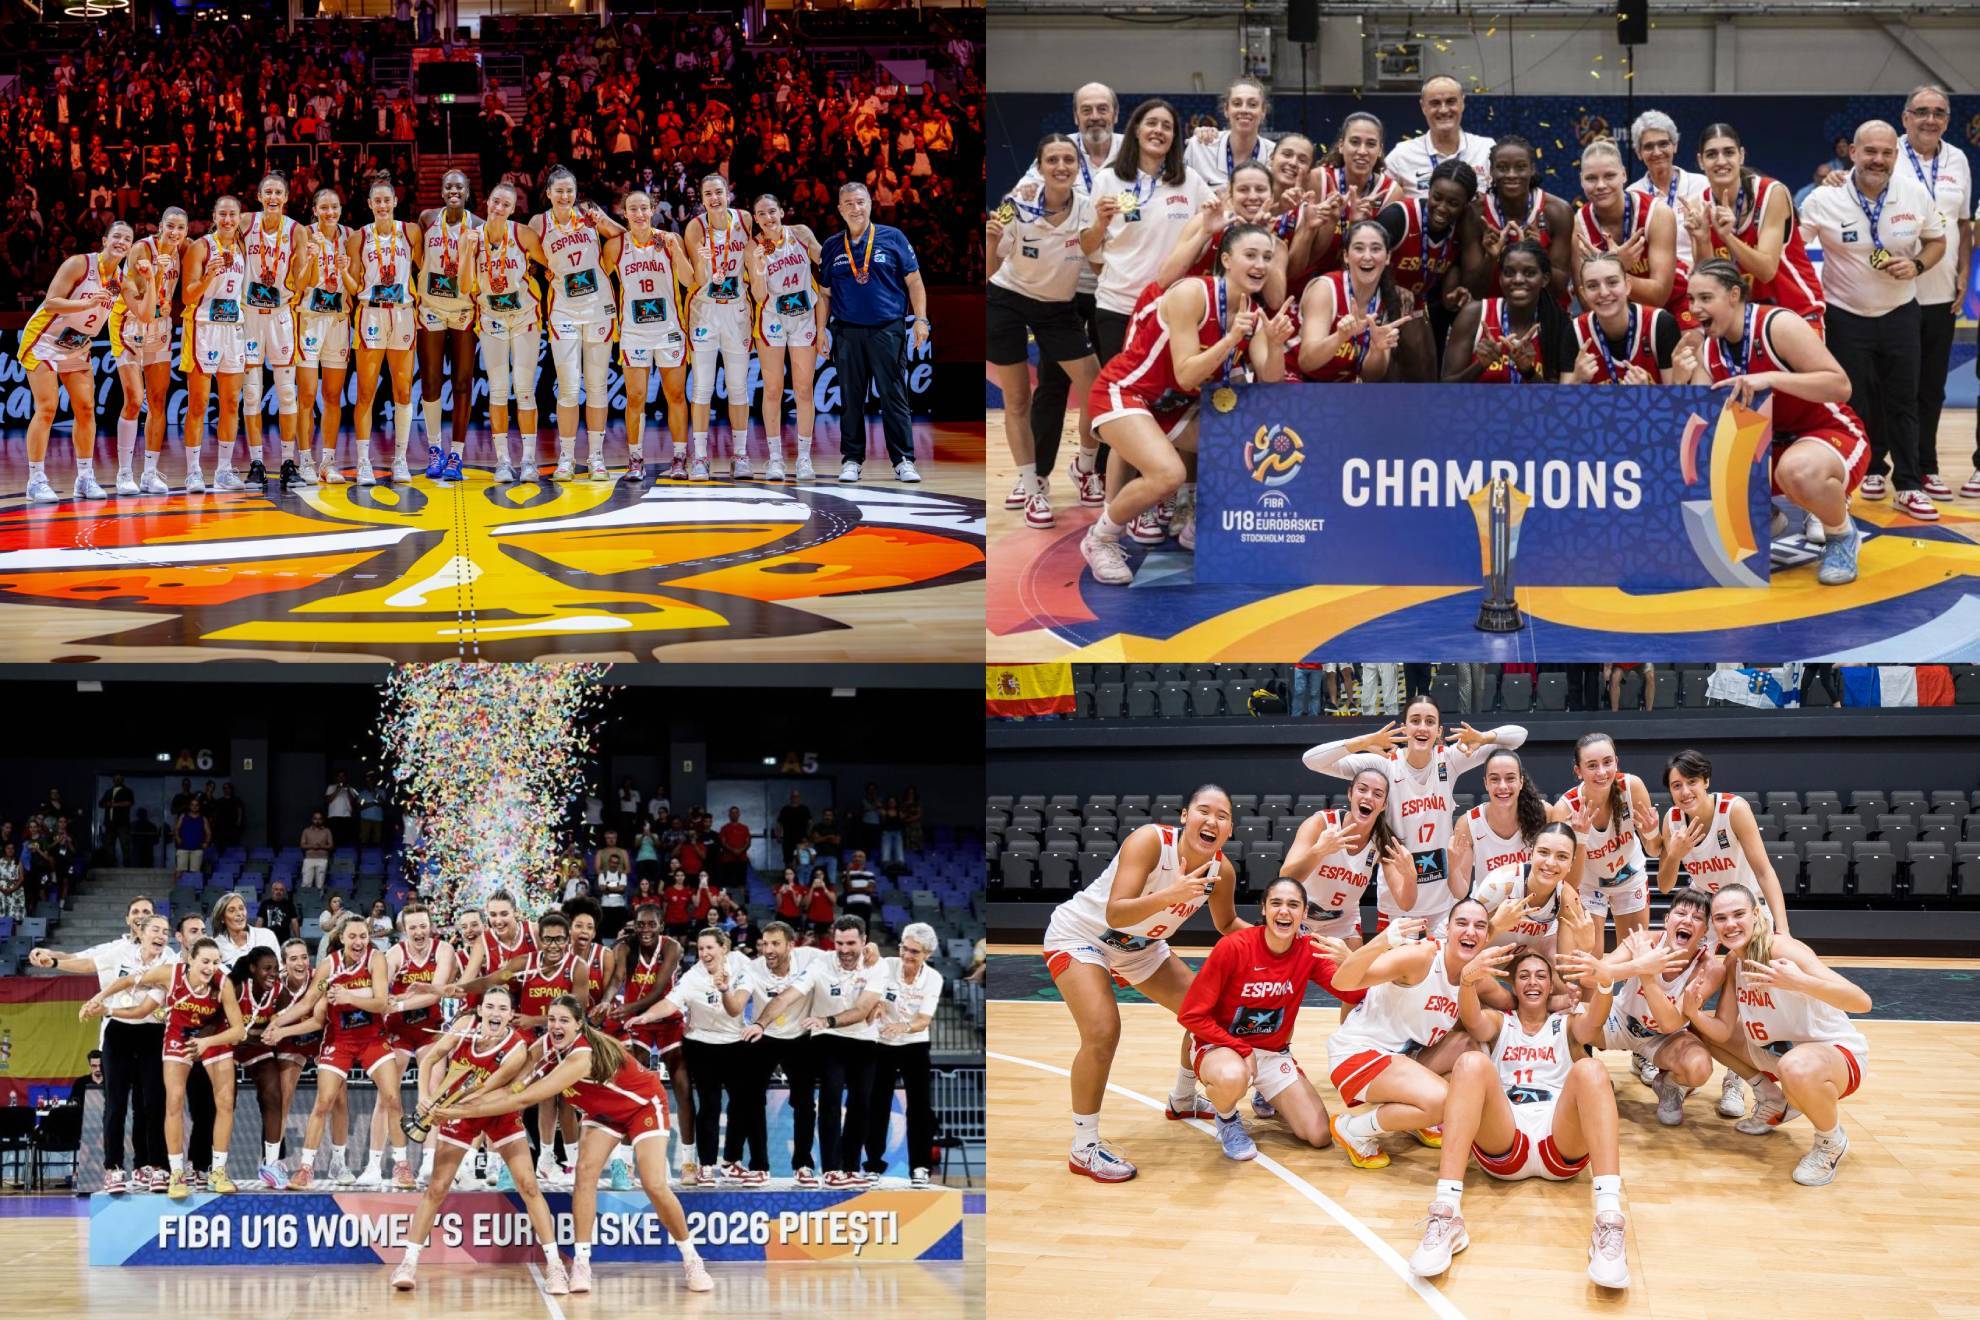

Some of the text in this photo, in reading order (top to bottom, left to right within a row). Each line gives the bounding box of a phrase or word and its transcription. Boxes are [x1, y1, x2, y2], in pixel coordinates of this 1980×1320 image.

[550, 231, 592, 254] ESPAÑA
[567, 250, 583, 268] 17
[624, 258, 667, 277] ESPAÑA
[767, 252, 806, 277] ESPAÑA
[226, 279, 236, 294] 5
[638, 278, 655, 293] 18
[782, 272, 800, 289] 44
[83, 313, 98, 328] 2
[1341, 457, 1643, 510] CHAMPIONS
[1263, 497, 1284, 509] FIBA
[1221, 510, 1255, 531] U18
[1255, 518, 1326, 532] EUROBASKET
[1240, 533, 1306, 544] STOCKHOLM 2026
[1401, 793, 1447, 817] ESPAÑA
[1418, 823, 1435, 844] 17
[1606, 855, 1625, 874] 14
[1330, 891, 1347, 907] 5
[1146, 924, 1168, 938] 8
[1745, 1021, 1769, 1041] 16
[1501, 1045, 1557, 1065] ESPAÑA
[1513, 1068, 1534, 1085] 11
[158, 1213, 232, 1250] FIBA
[241, 1212, 299, 1250] U16
[472, 1210, 678, 1249] EURBSKE
[688, 1210, 771, 1247] 2026
